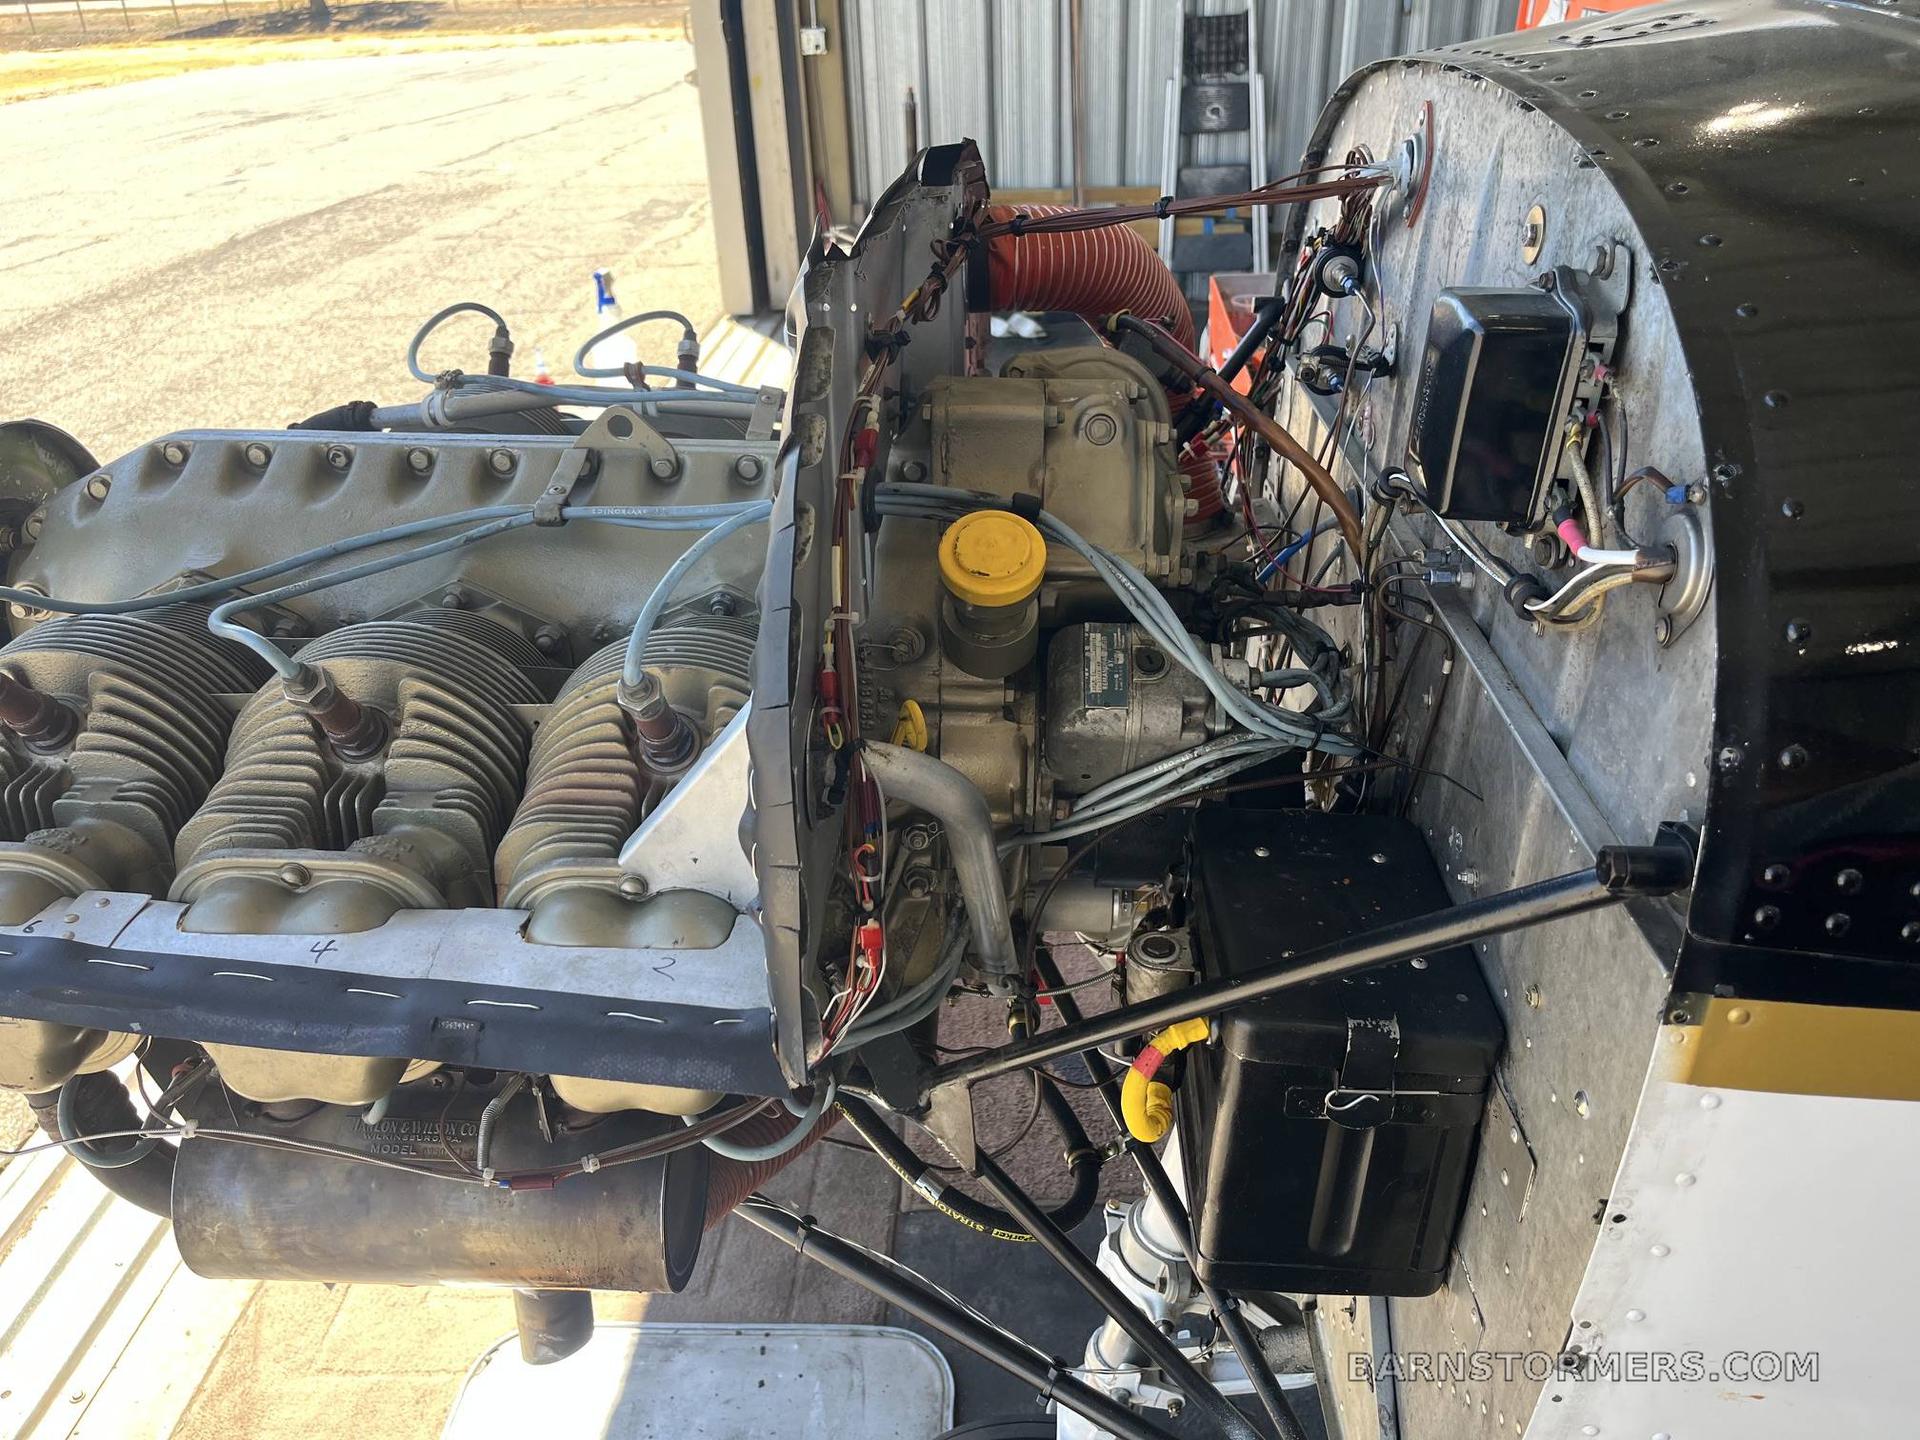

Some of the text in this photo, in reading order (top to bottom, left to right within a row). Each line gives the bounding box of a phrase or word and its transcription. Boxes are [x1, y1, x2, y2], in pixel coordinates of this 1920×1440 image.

[23, 919, 43, 933] 6
[310, 939, 338, 964] 4
[652, 956, 676, 981] 2
[460, 1123, 479, 1137] CO.
[370, 1143, 418, 1156] MODEL
